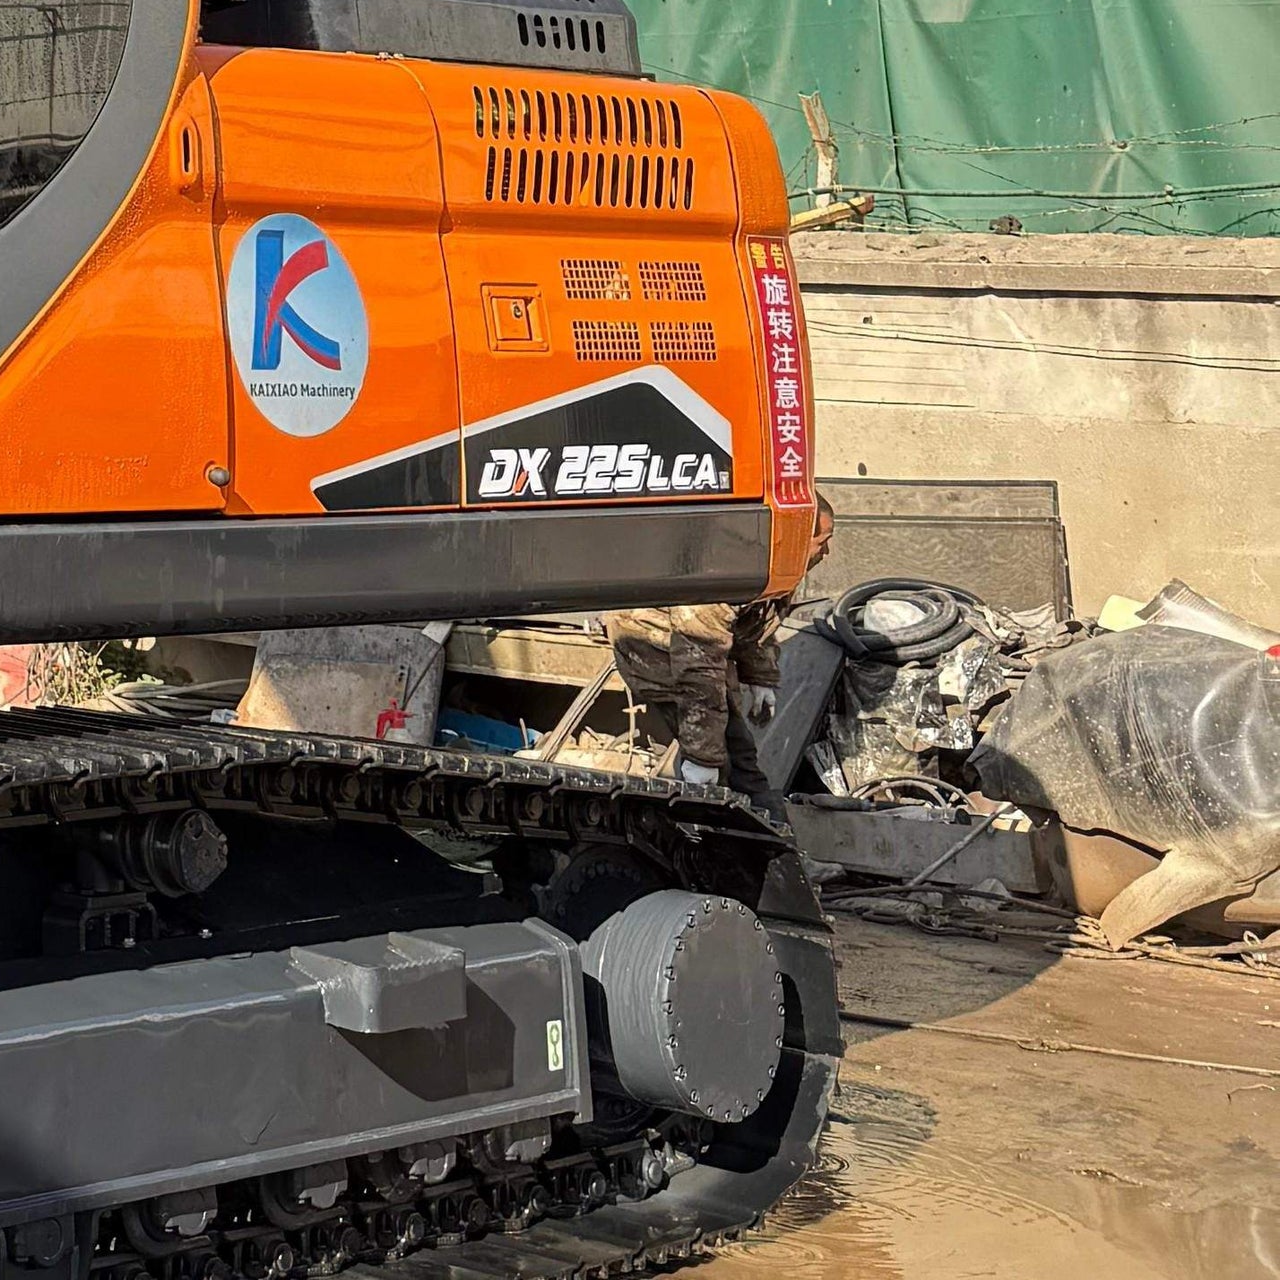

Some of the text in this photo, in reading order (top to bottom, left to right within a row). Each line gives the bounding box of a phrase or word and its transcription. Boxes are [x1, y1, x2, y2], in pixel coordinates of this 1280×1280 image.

[250, 382, 356, 401] KAIXIAO Machinery
[479, 448, 551, 497] DX
